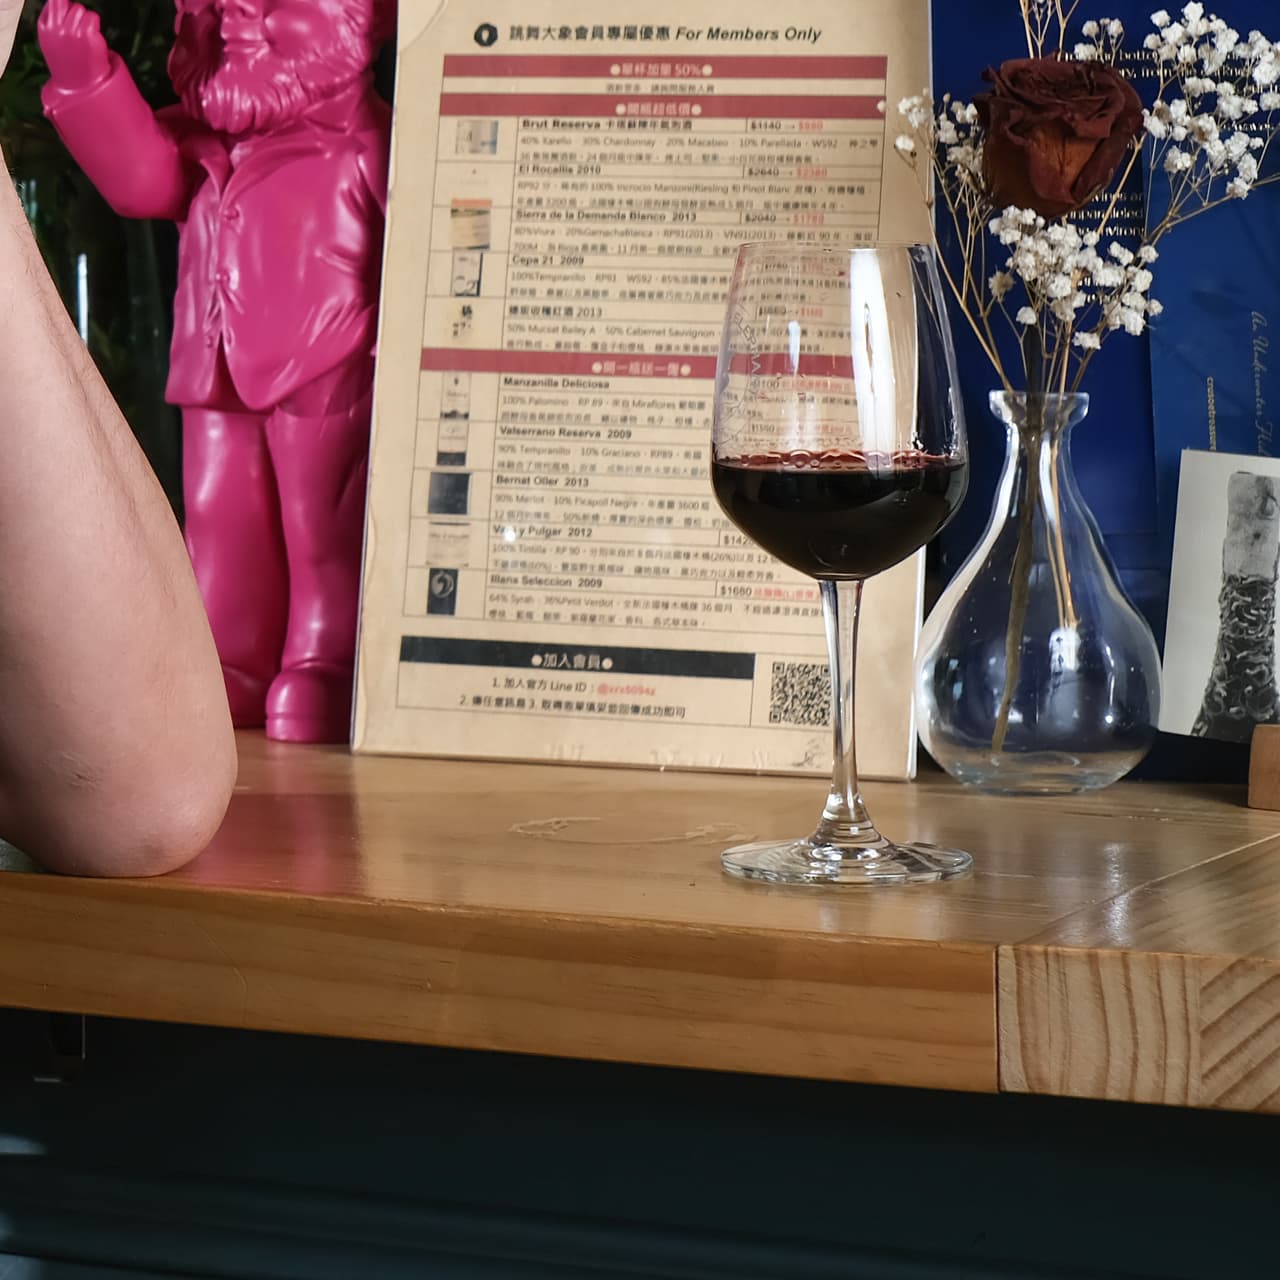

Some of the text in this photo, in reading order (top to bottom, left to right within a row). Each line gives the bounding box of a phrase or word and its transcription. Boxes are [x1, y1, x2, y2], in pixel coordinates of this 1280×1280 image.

[509, 25, 822, 43] 跳舞大象會員專屬優惠 For Members Only
[674, 63, 701, 77] 50%
[523, 120, 547, 129] Brut
[552, 120, 600, 129] Reserva
[519, 165, 529, 174] El
[577, 165, 602, 175] 2010
[516, 210, 546, 220] Sierra
[549, 210, 562, 220] de
[577, 211, 626, 221] Demanda
[629, 211, 666, 221] Blanco
[672, 212, 697, 222] 2013
[512, 256, 584, 267] Cepa 21 2009
[577, 306, 602, 317] 2013
[626, 326, 666, 337] Cabernet
[669, 328, 715, 339] Sauvignon
[504, 377, 610, 389] Manzanilla Deliciosa
[632, 399, 676, 410] Miraflores
[500, 426, 632, 439] Valserrano Reserva 2009
[520, 445, 571, 458] Tempranillo
[601, 447, 641, 459] Graciano
[496, 474, 589, 487] Bernat Oller 2013
[528, 526, 562, 538] Pulgar
[568, 527, 592, 538] 2012
[521, 575, 572, 587] Seleccion
[578, 577, 603, 588] 2009
[543, 653, 601, 670] 加入會員
[504, 677, 547, 692] 加入官方
[550, 679, 572, 693] Line
